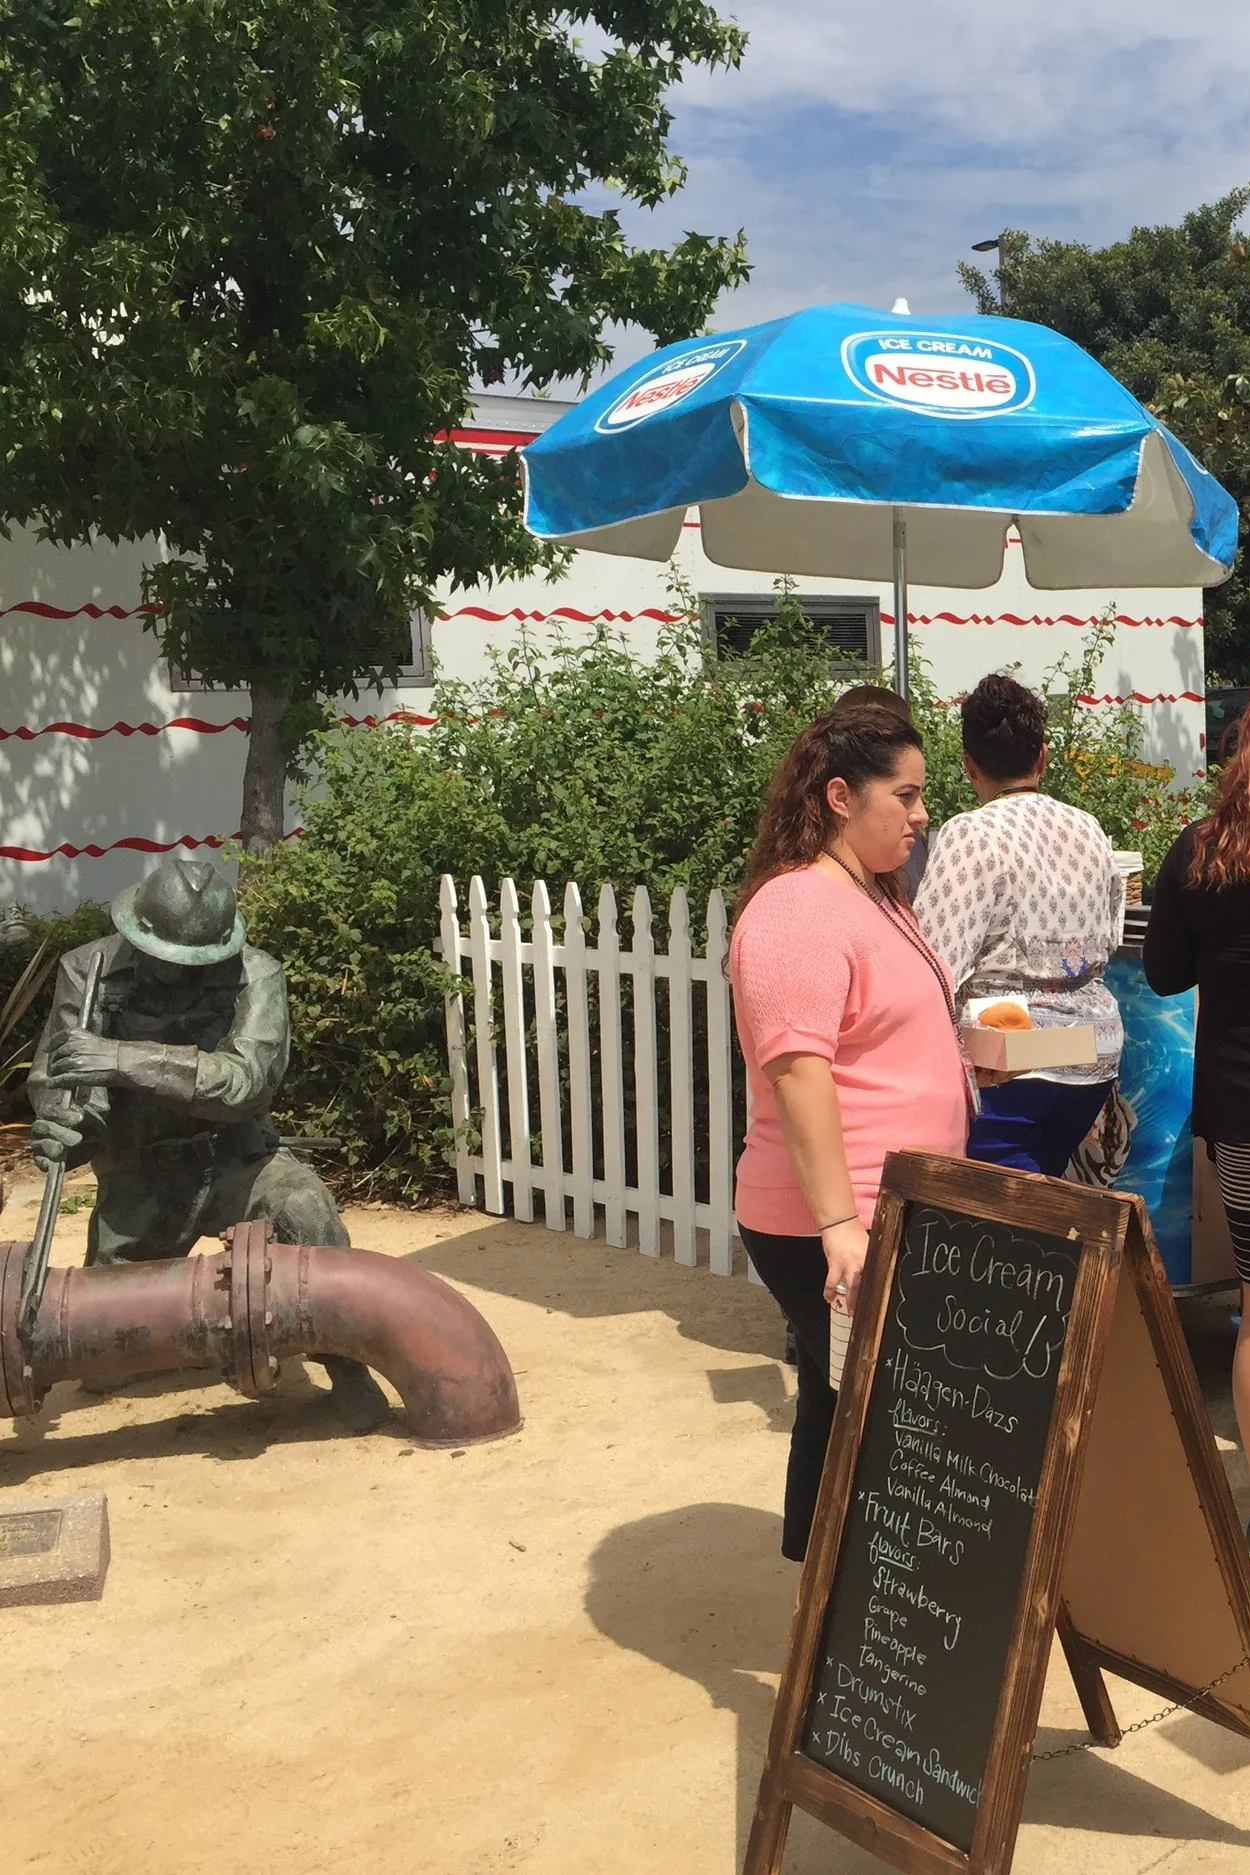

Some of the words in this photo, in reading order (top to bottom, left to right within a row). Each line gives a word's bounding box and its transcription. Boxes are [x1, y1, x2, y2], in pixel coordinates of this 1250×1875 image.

[877, 338, 913, 350] ICE
[916, 340, 993, 360] CREAM
[912, 1220, 961, 1276] Ice
[970, 1234, 1064, 1312] Cream
[889, 1448, 936, 1483] Coffee
[939, 1474, 991, 1511] Almond
[895, 1430, 942, 1463] Vanilla
[946, 1450, 978, 1477] Milk
[864, 1492, 911, 1548] Fruit
[916, 1516, 964, 1566] Bars
[887, 1476, 931, 1511] Vanilla
[934, 1501, 993, 1541] Almond
[868, 1531, 921, 1570] flavors:
[868, 1595, 908, 1631] Grape
[872, 1565, 962, 1650] Strawberry
[864, 1616, 928, 1666] Pineapple
[837, 1662, 917, 1732] Drumstix
[859, 1645, 927, 1696] Tangerine
[829, 1694, 862, 1728] Ice
[863, 1717, 920, 1766] Cream
[868, 1755, 924, 1805] Crunch
